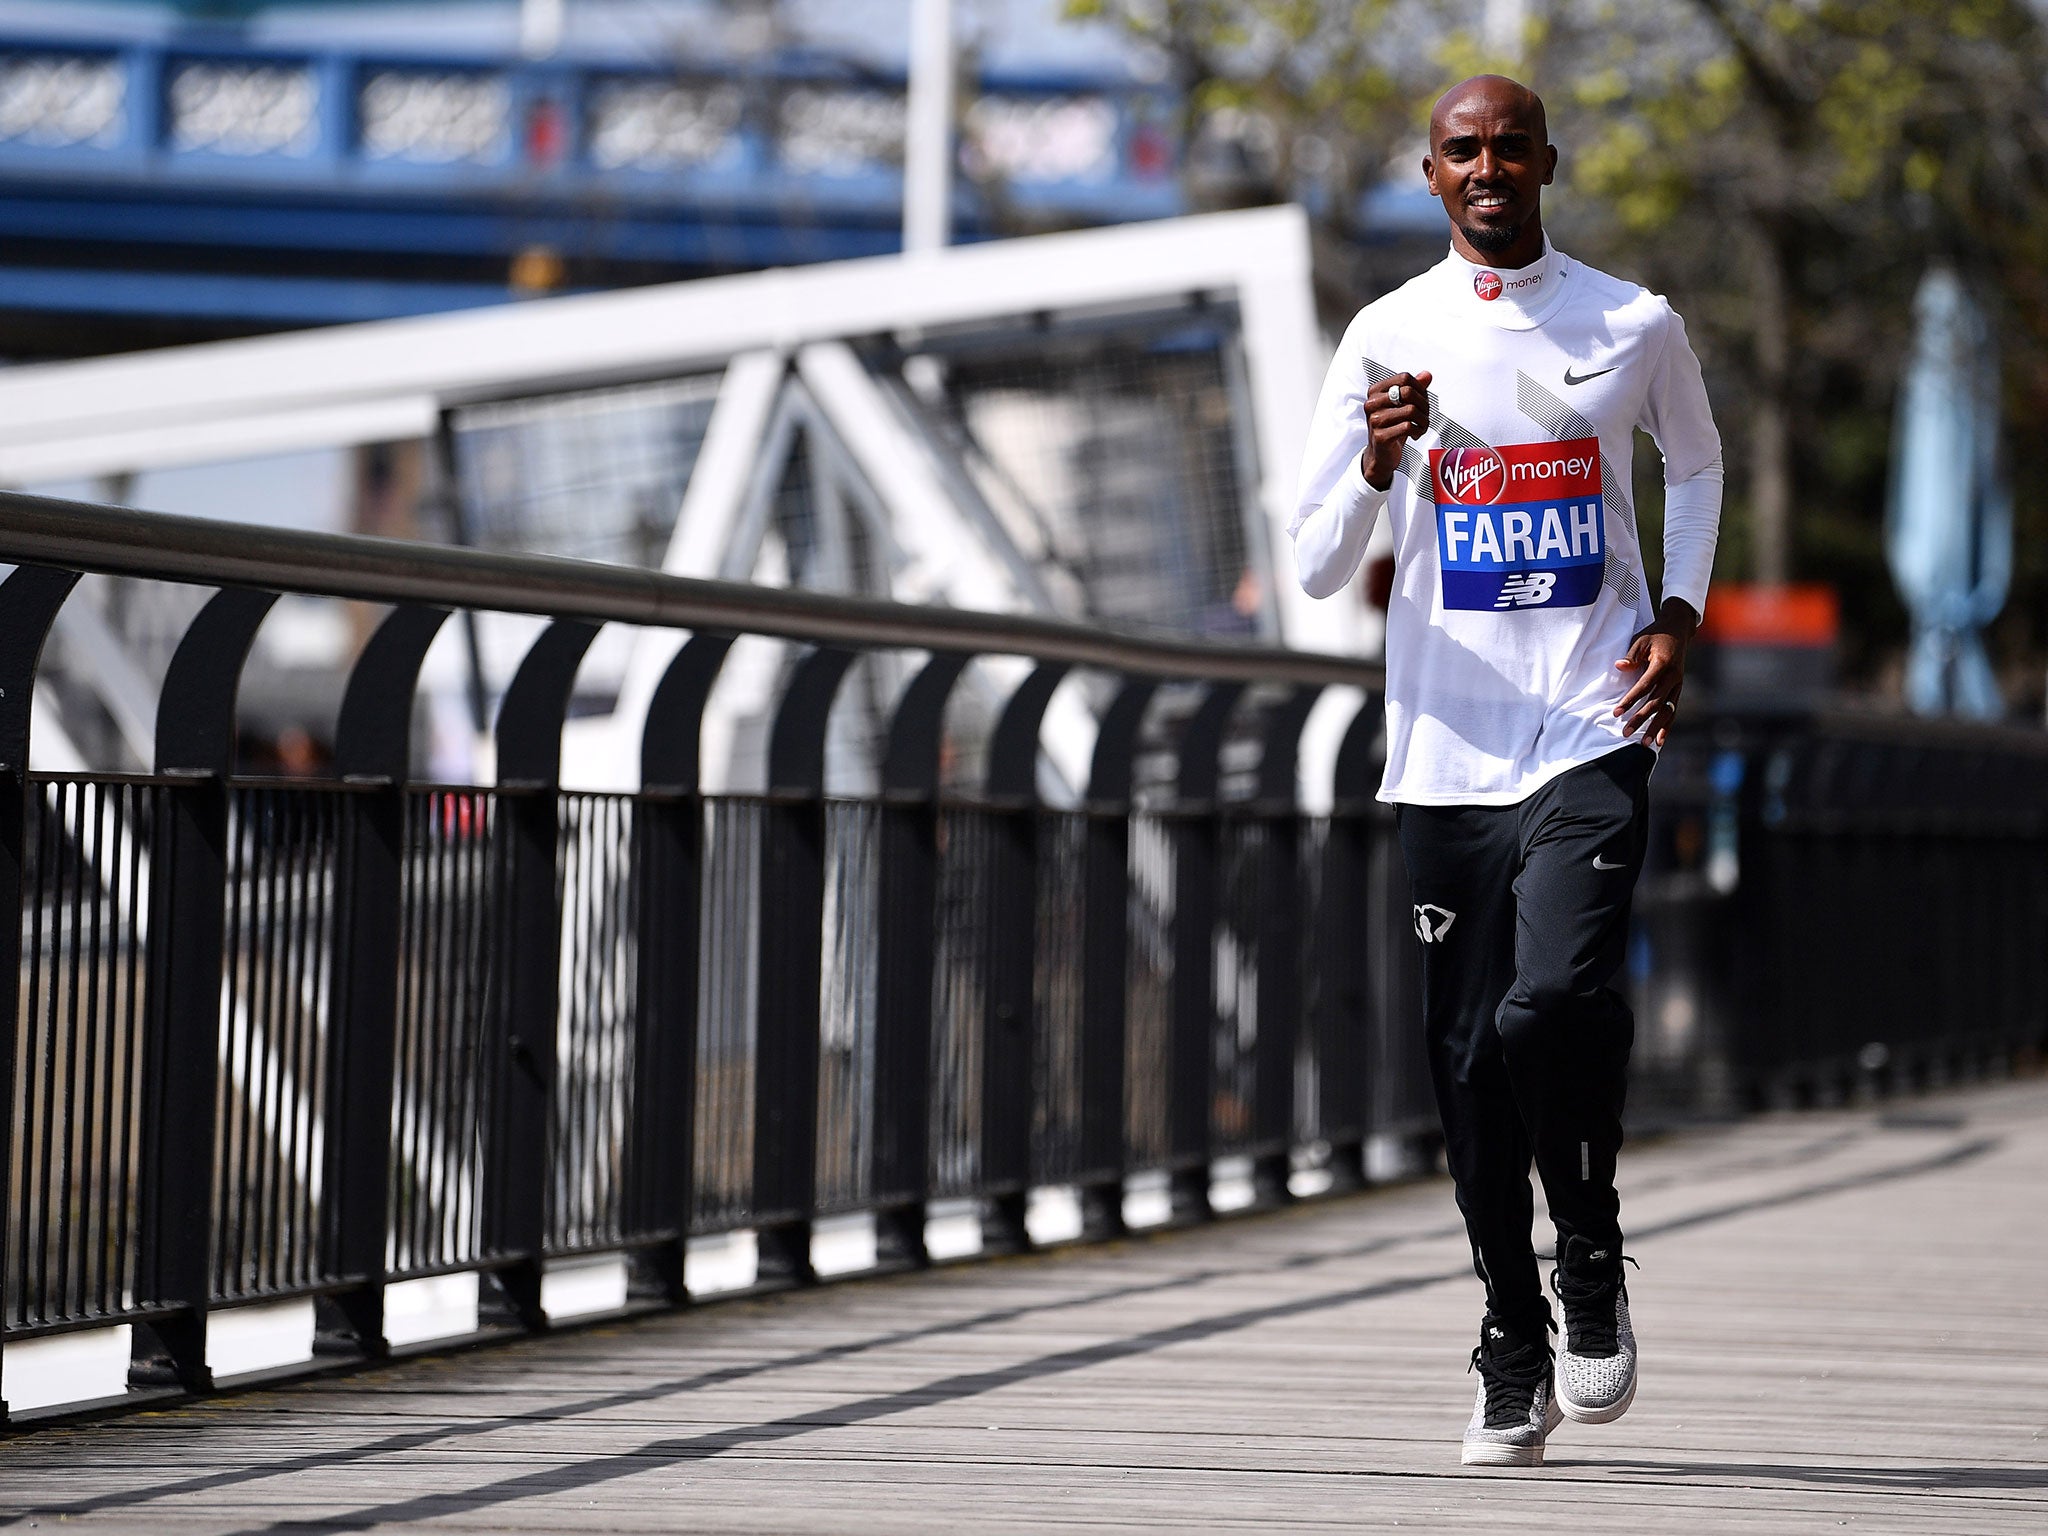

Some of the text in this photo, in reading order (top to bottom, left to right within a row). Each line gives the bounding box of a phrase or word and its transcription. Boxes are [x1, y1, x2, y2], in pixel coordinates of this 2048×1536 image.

[1475, 273, 1501, 298] Virgin
[1506, 272, 1543, 290] money
[1444, 447, 1594, 500] Virgin money
[1444, 503, 1599, 563] FARAH
